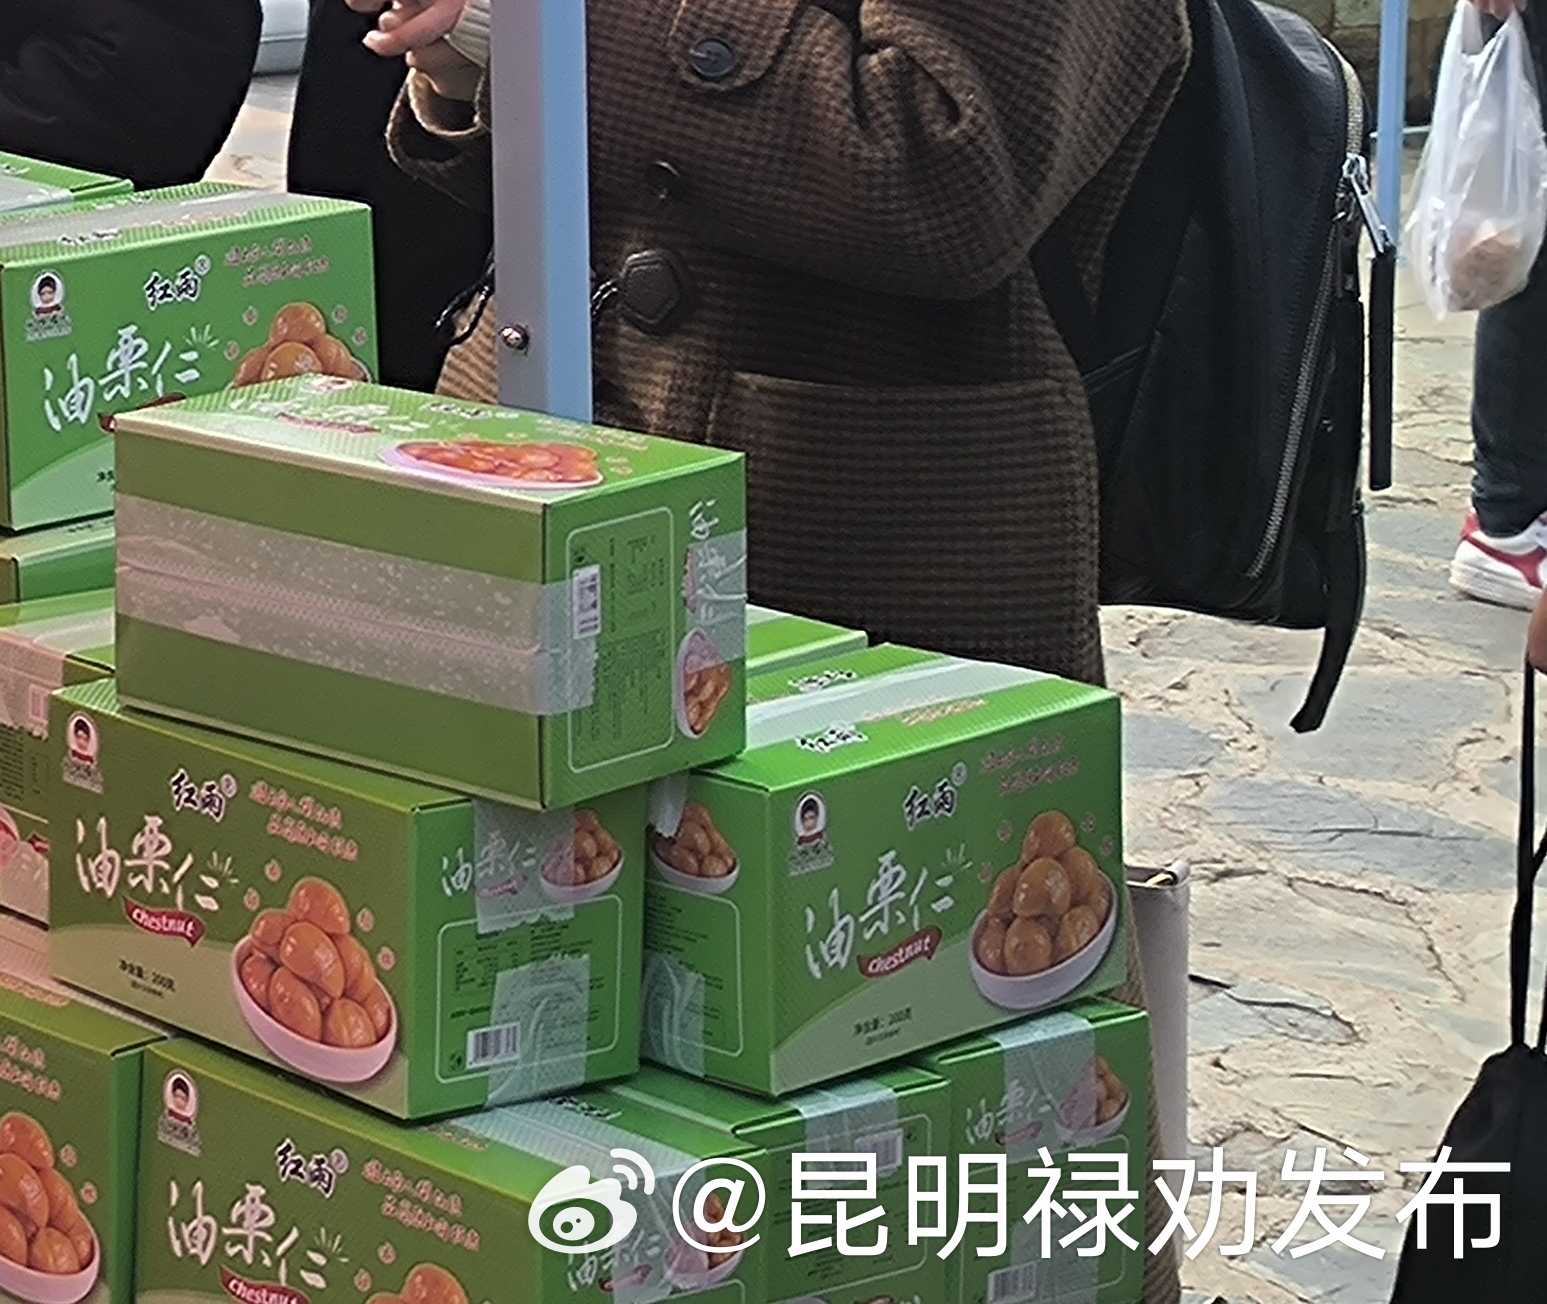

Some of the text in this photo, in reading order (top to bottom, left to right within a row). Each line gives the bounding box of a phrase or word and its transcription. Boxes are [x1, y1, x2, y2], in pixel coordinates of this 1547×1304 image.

[145, 266, 201, 311] 红雨
[43, 325, 202, 434] 油栗仁
[169, 769, 229, 823] 红雨
[903, 778, 958, 834] 红雨
[75, 814, 221, 912] 油栗仁
[805, 850, 955, 980] 油栗仁
[273, 1137, 335, 1200] 红雨
[164, 1181, 328, 1290] 油栗仁
